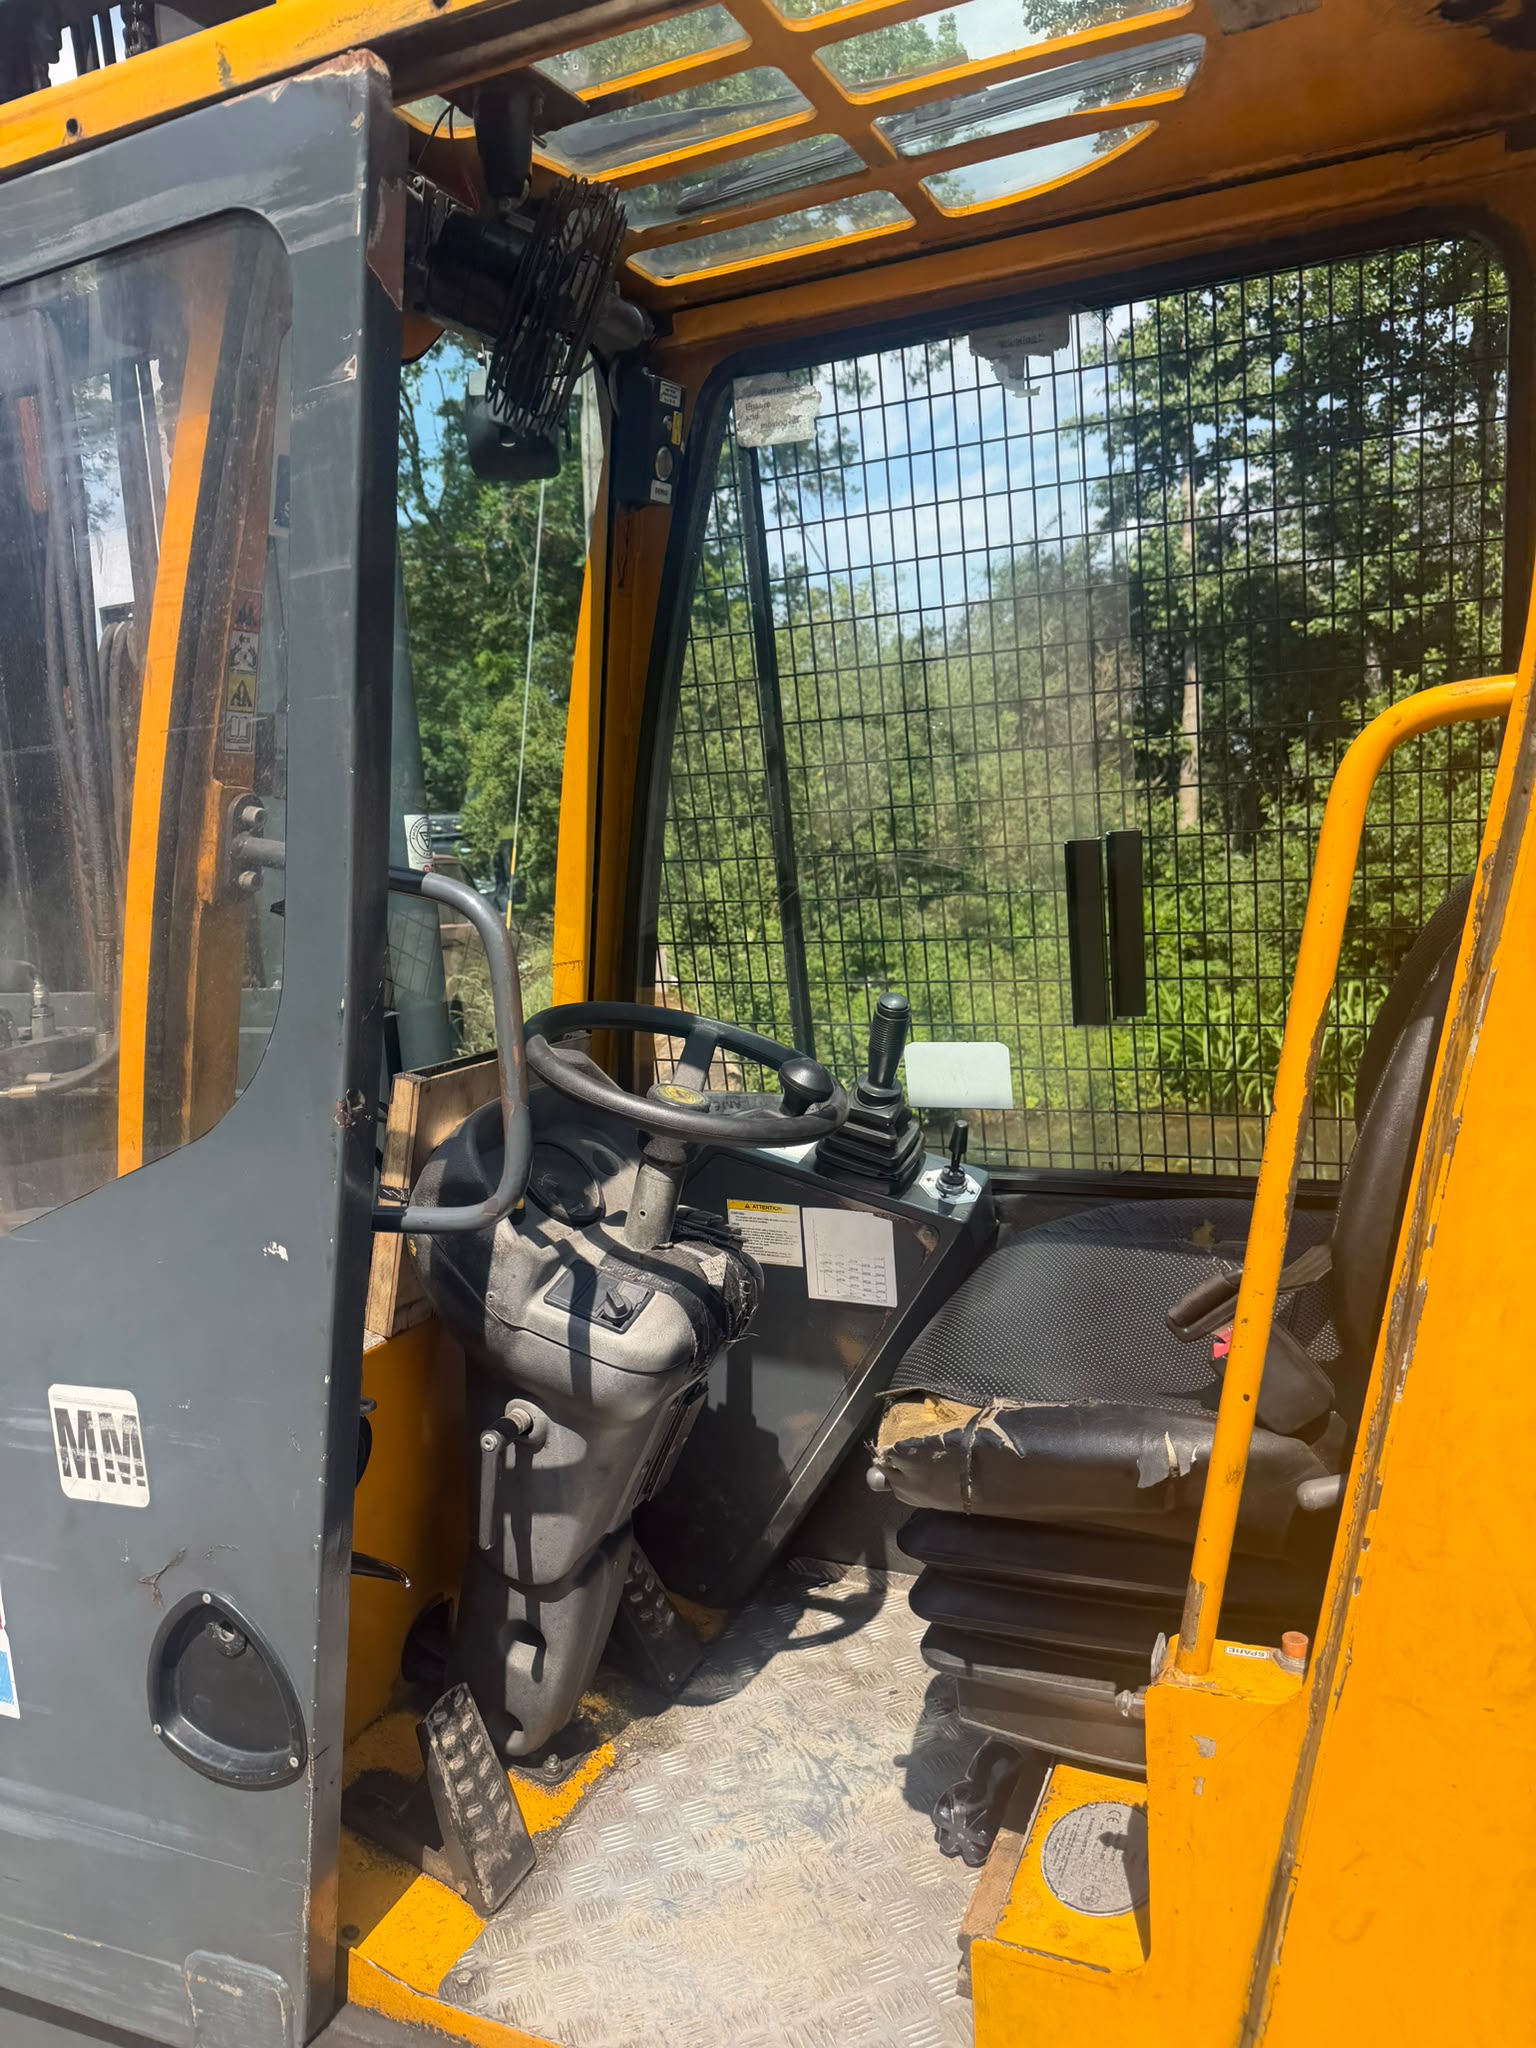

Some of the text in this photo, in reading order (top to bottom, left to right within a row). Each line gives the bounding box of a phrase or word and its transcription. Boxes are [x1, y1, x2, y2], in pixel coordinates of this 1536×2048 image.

[752, 1204, 783, 1212] ATTENTION
[54, 1407, 146, 1488] MM
[1229, 1648, 1266, 1657] SPARE
